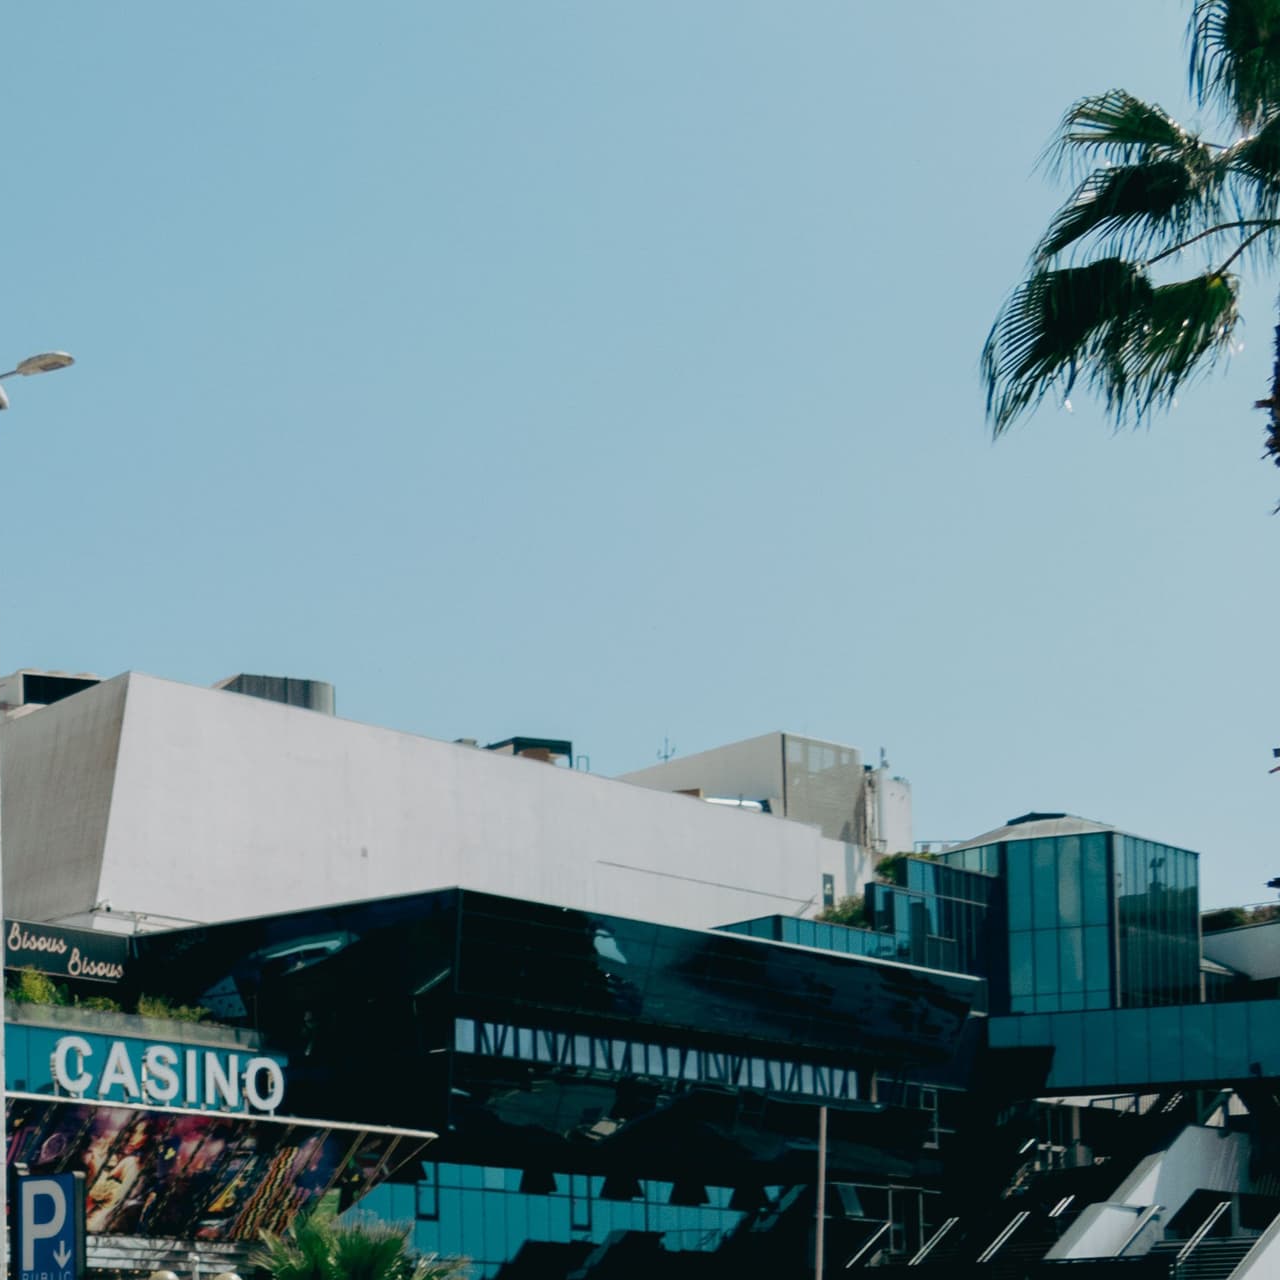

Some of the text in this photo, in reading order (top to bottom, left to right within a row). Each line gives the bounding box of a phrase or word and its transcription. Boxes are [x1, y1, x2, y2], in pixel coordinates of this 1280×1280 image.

[7, 921, 68, 955] Bisous
[67, 948, 124, 979] Bisous
[51, 1035, 285, 1112] CASINO
[21, 1179, 67, 1271] P
